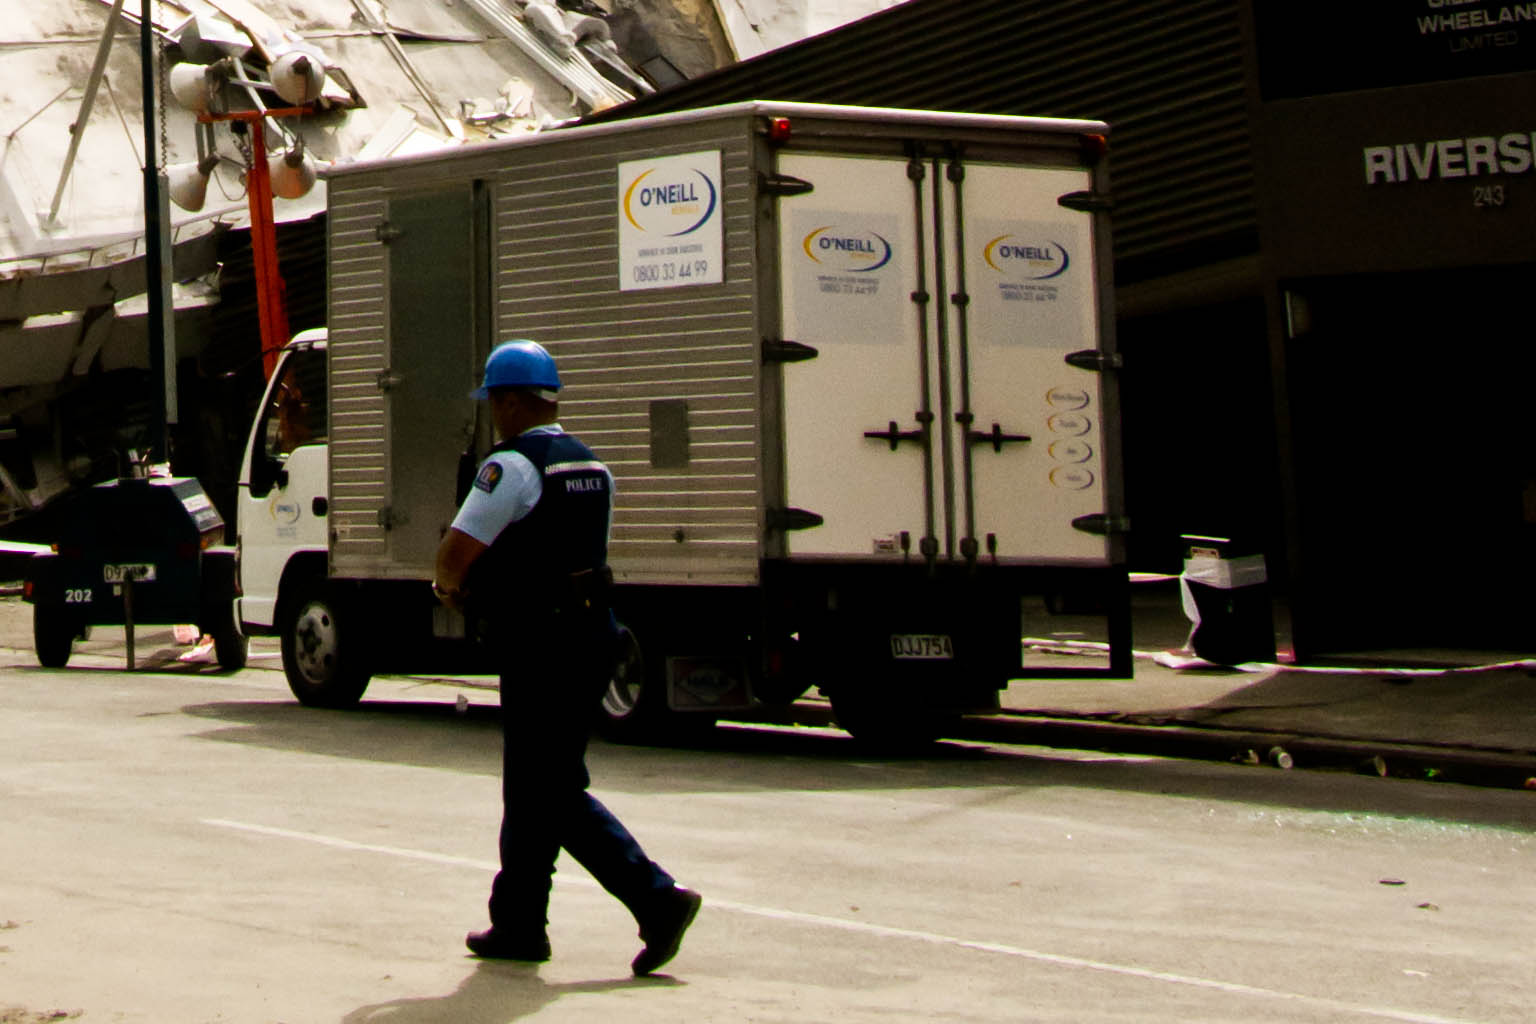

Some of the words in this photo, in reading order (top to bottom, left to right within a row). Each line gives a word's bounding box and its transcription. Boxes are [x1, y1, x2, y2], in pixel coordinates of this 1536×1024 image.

[1449, 30, 1518, 53] LIMITED
[1473, 185, 1504, 207] 243
[633, 264, 659, 283] 0800
[678, 263, 692, 277] 44
[565, 478, 603, 492] POLICE
[65, 589, 92, 602] 202
